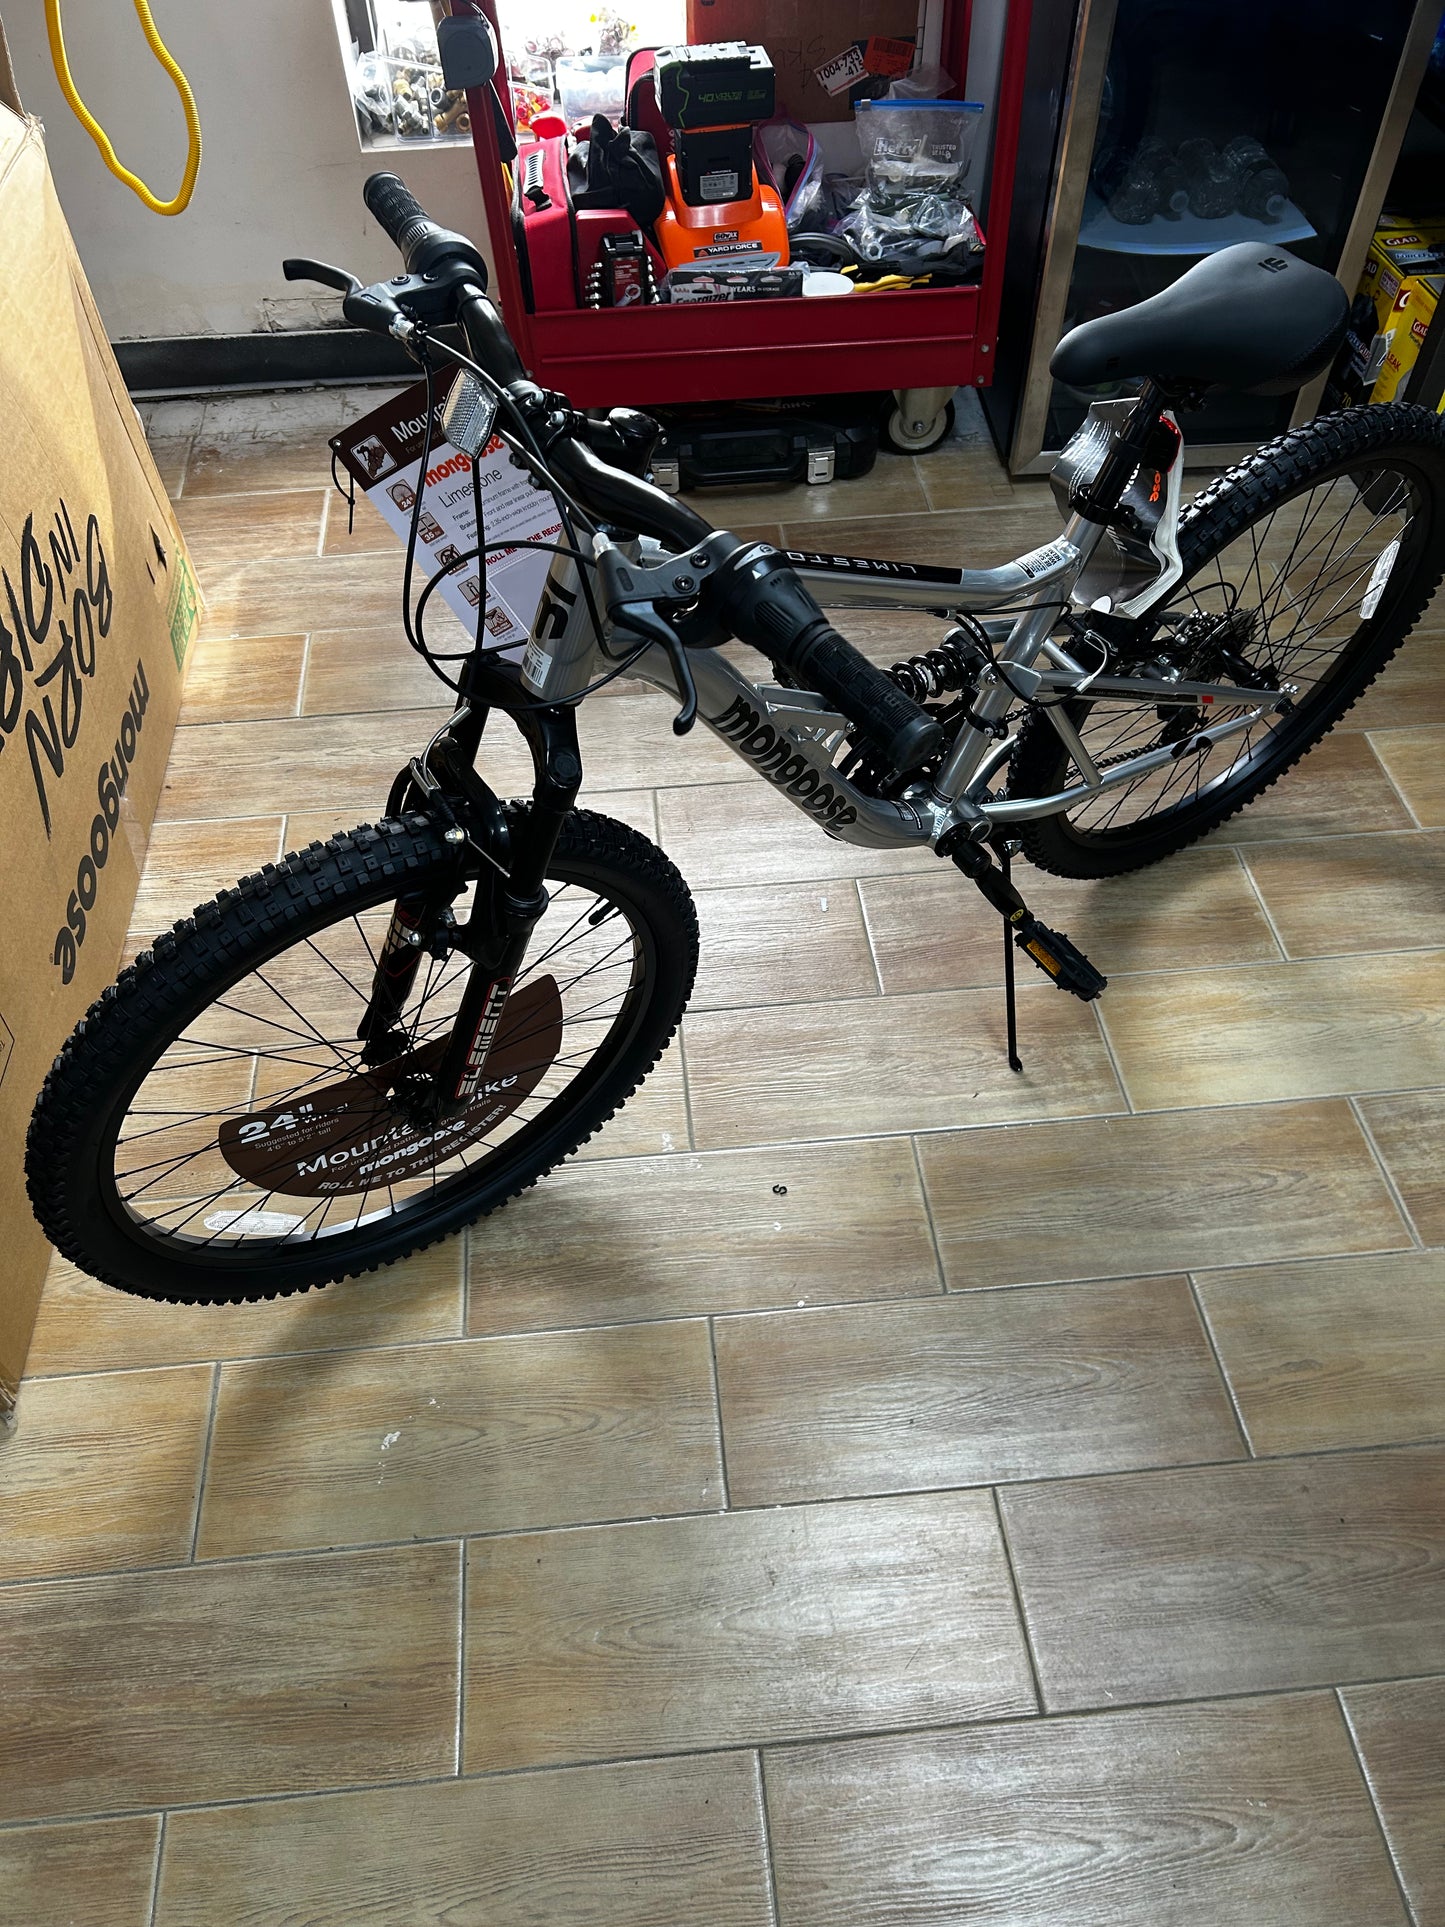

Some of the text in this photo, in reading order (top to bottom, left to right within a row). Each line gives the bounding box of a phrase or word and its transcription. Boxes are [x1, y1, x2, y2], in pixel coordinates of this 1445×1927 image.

[1386, 236, 1418, 246] GLAD
[732, 286, 756, 294] YEARS
[439, 469, 502, 508] Limesone
[50, 497, 81, 605] IN
[485, 551, 506, 566] ROLL
[541, 521, 563, 538] REGIS
[786, 551, 918, 574] LIMESTO
[0, 512, 53, 752] DIR
[26, 513, 113, 842] BORN
[708, 694, 858, 832] mongoose
[54, 657, 151, 986] mongoose
[238, 1103, 314, 1144] 24"
[254, 1117, 340, 1149] Suggested for riders
[297, 1123, 414, 1176] Mounta
[317, 1104, 507, 1190] ROLL ME TO THE REGISTER!
[318, 1127, 332, 1136] tall
[331, 1162, 348, 1173] For
[393, 1132, 420, 1148] paths
[469, 1099, 492, 1111] trails
[359, 1120, 467, 1175] mongoose
